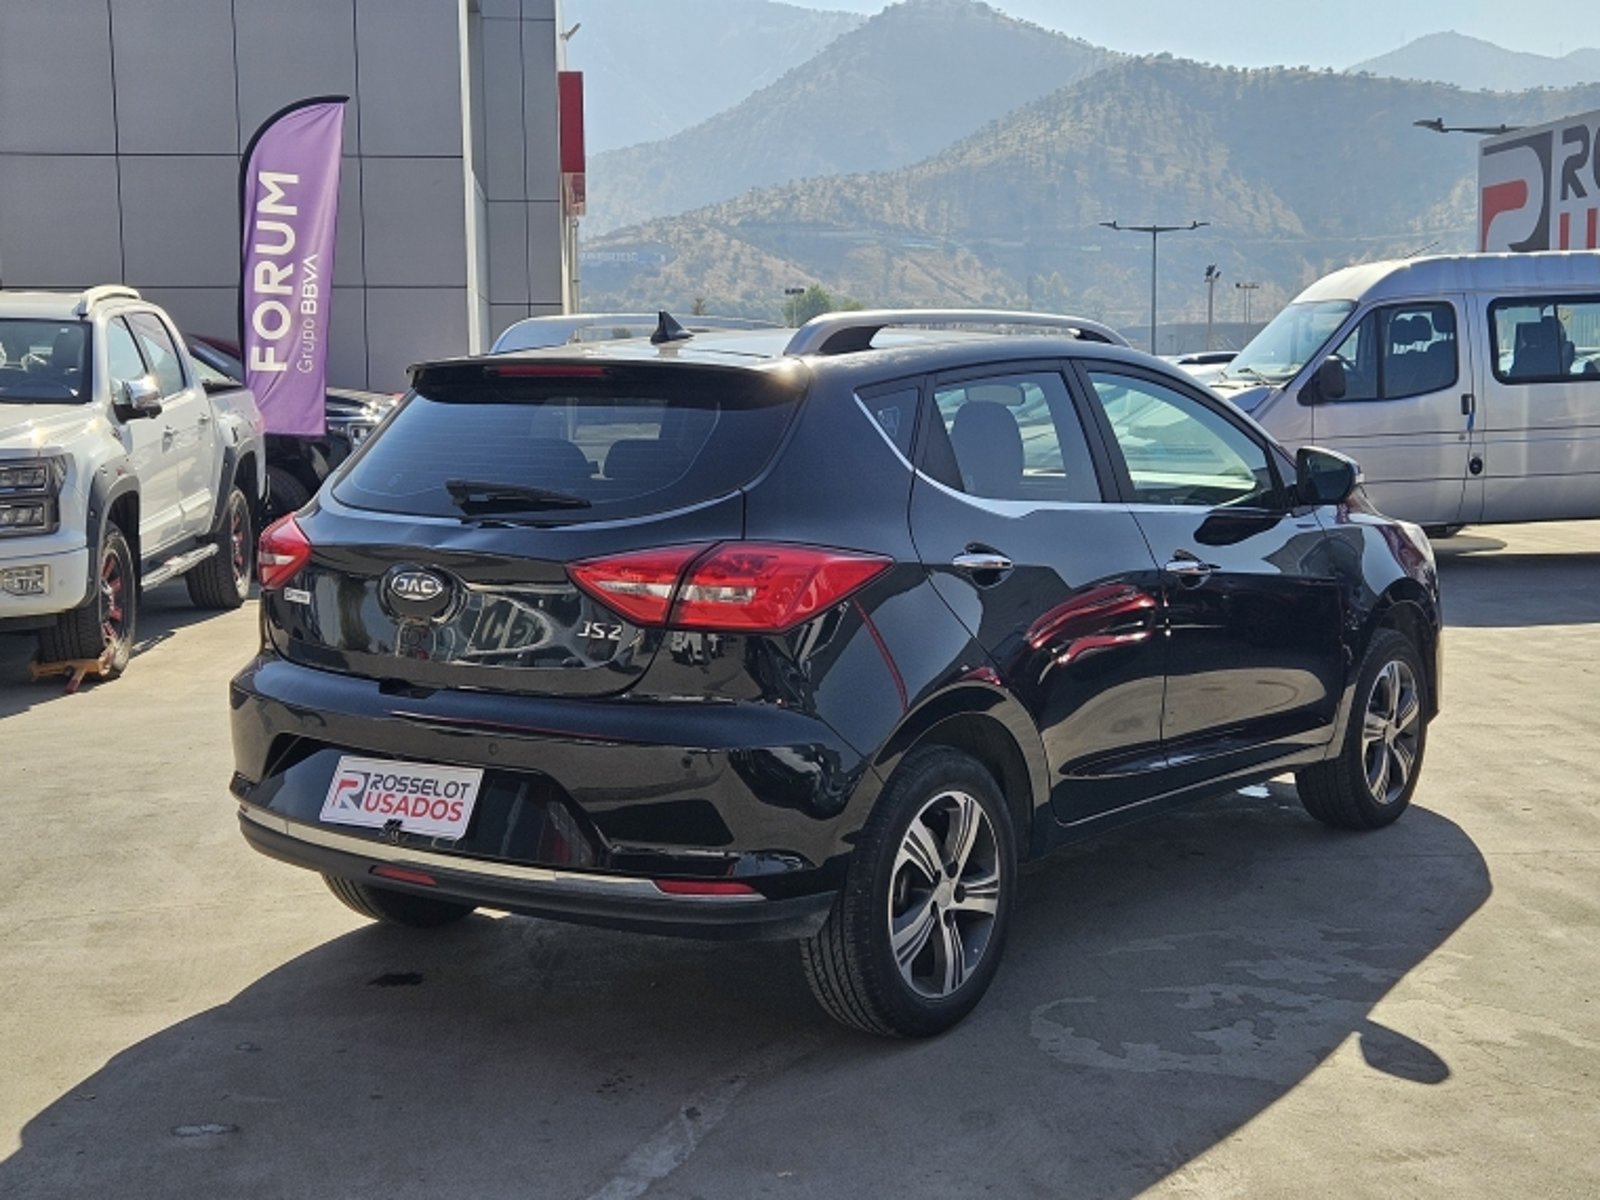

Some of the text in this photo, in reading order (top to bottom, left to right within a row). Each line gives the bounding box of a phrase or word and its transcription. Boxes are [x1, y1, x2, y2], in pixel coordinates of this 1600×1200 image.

[1560, 122, 1600, 202] R
[250, 171, 300, 373] FORUM
[296, 254, 319, 375] Grupo BBVA
[396, 578, 438, 594] JAC
[576, 620, 622, 641] JS2
[370, 773, 471, 800] ROSSELOT
[364, 792, 465, 823] USADOS
